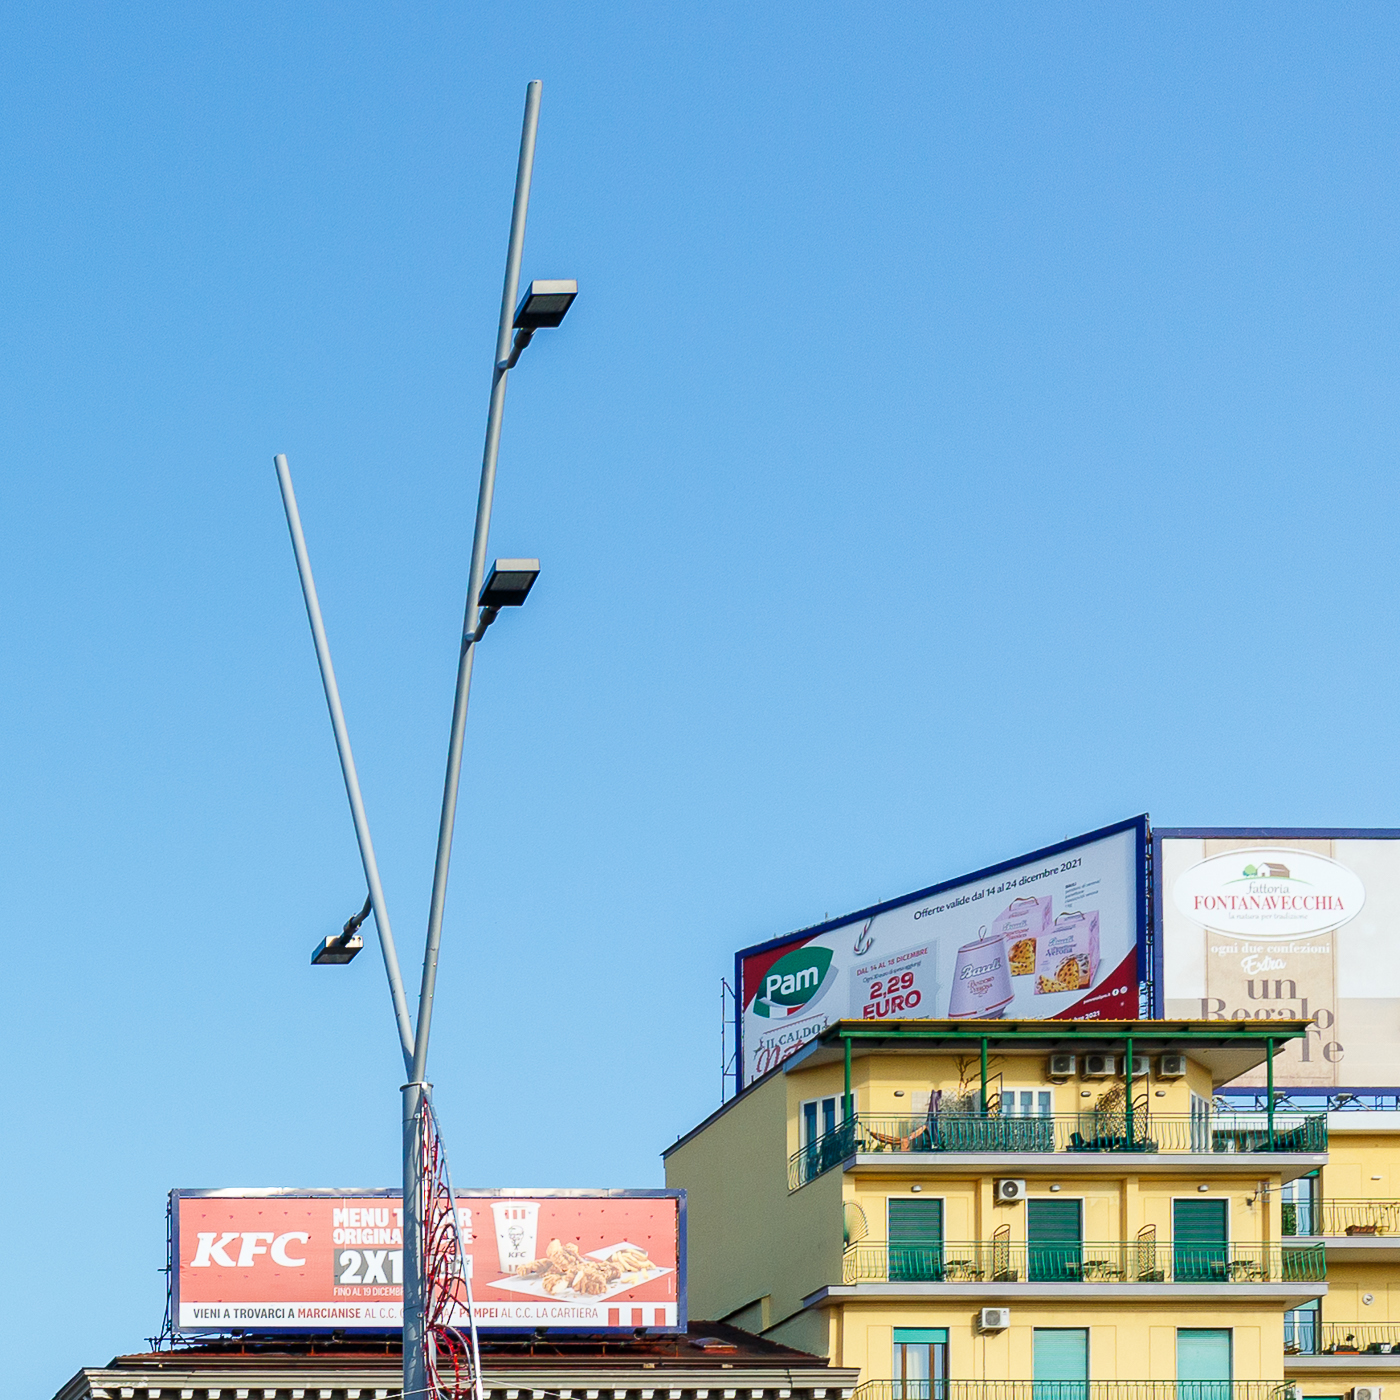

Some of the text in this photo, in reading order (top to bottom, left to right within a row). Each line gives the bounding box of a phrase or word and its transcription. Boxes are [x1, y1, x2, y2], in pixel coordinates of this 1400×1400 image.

[913, 857, 1082, 921] Offerte valide dal 14 al 24 dicembre 2021
[1246, 881, 1290, 895] fattoria
[1194, 895, 1345, 911] FONTANAVECCHIA
[1211, 942, 1330, 956] ogni due confezioni
[856, 967, 868, 976] DAL
[878, 961, 886, 970] AL
[896, 947, 928, 964] DICEMBRE
[1241, 954, 1286, 976] Extra
[766, 966, 819, 1000] Pam
[870, 971, 914, 1000] 2,29
[1244, 978, 1297, 1000] un
[863, 989, 922, 1019] EURO
[766, 1024, 821, 1049] IL CALDO
[333, 1208, 389, 1227] MENU
[333, 1228, 403, 1245] ORIGINA
[190, 1231, 309, 1267] KFC
[508, 1251, 526, 1259] KFC
[333, 1286, 403, 1296] FINO AL 19 DICEMB
[193, 1308, 221, 1319] VIENI
[223, 1308, 231, 1319] A
[233, 1308, 285, 1319] TROVARCI
[287, 1308, 295, 1319] A
[298, 1307, 361, 1319] MARCIANISE
[364, 1307, 377, 1318] AL
[379, 1307, 397, 1318] C.C.
[501, 1306, 513, 1318] AL
[515, 1306, 533, 1318] C.C.
[536, 1306, 548, 1318] LA
[550, 1306, 598, 1318] CARTIERA
